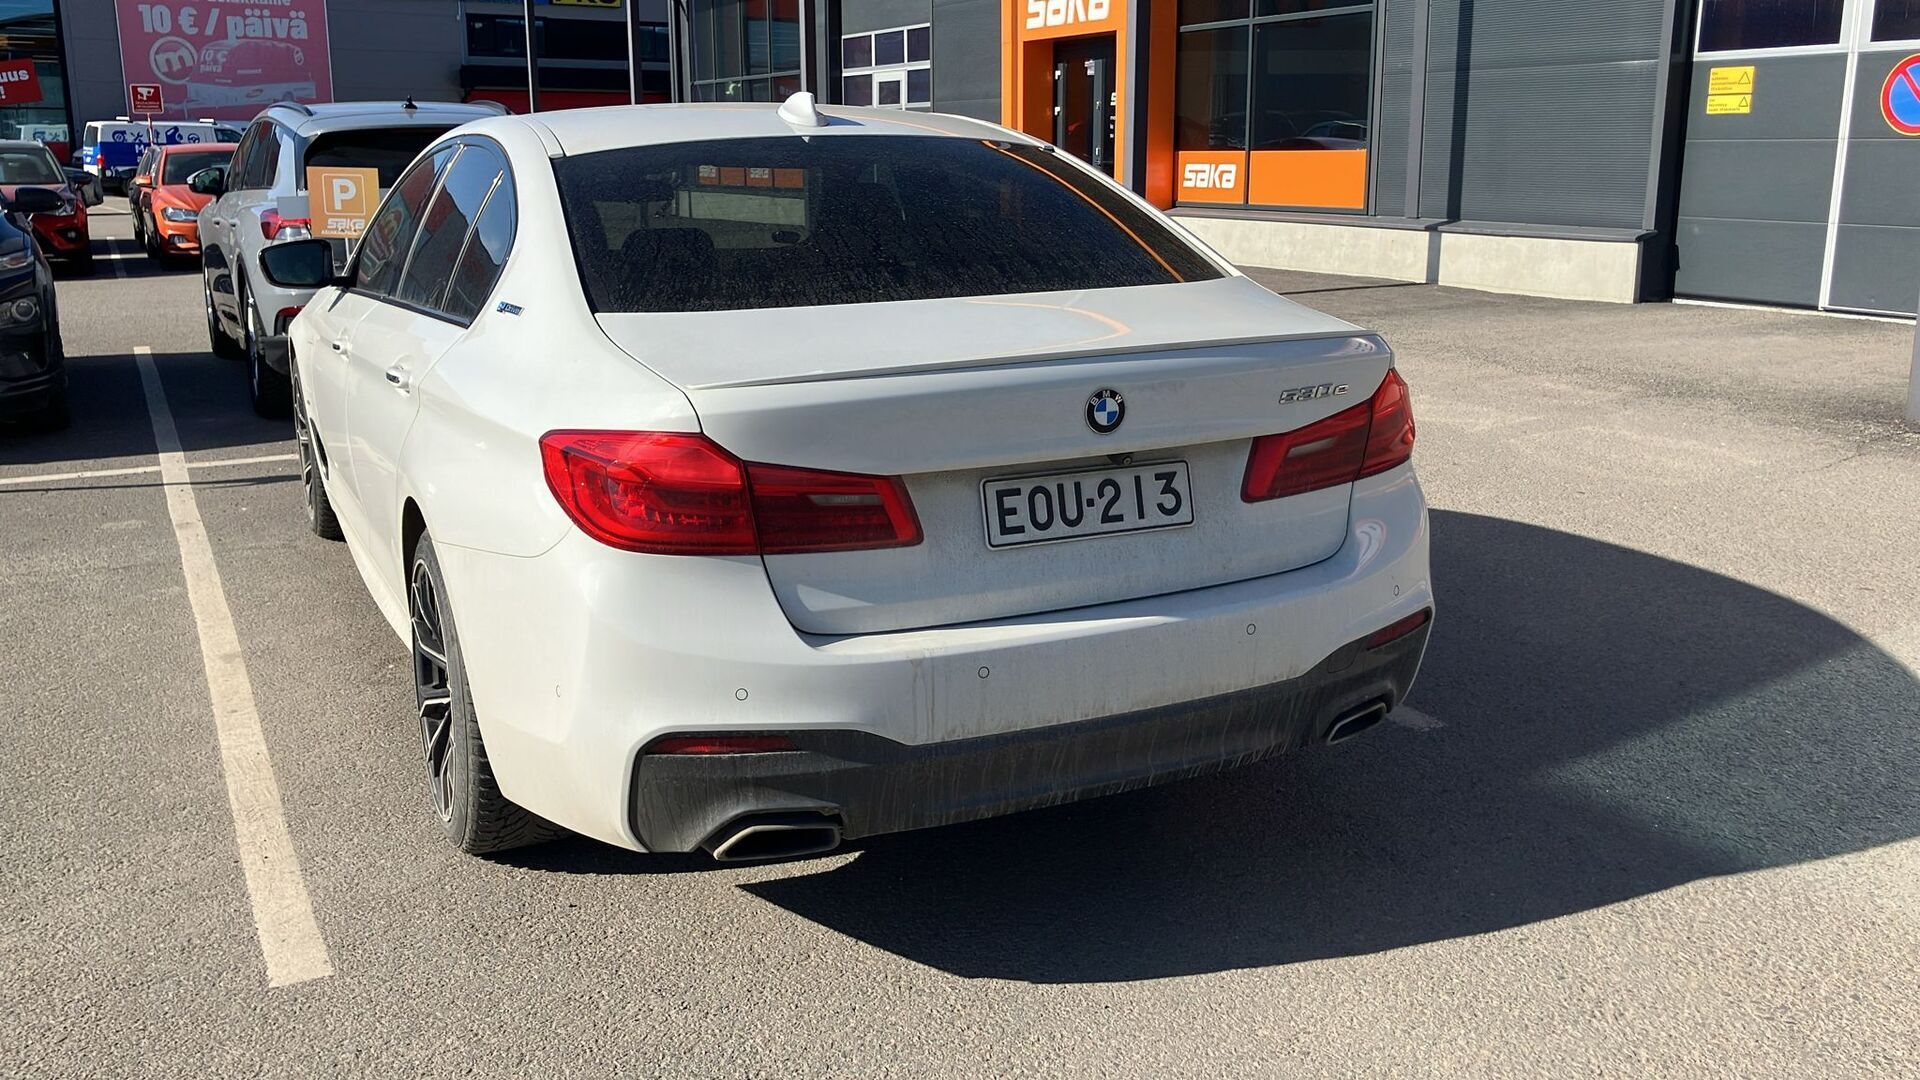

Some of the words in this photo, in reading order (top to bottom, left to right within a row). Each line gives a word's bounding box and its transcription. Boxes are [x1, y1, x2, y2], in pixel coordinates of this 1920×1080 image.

[138, 4, 172, 33] 10
[178, 6, 199, 35] €
[205, 8, 220, 36] /
[226, 8, 308, 42] päivä
[333, 178, 356, 210] P
[1090, 390, 1123, 405] BMW
[1279, 383, 1349, 404] 530e
[995, 471, 1182, 536] EOU-213
